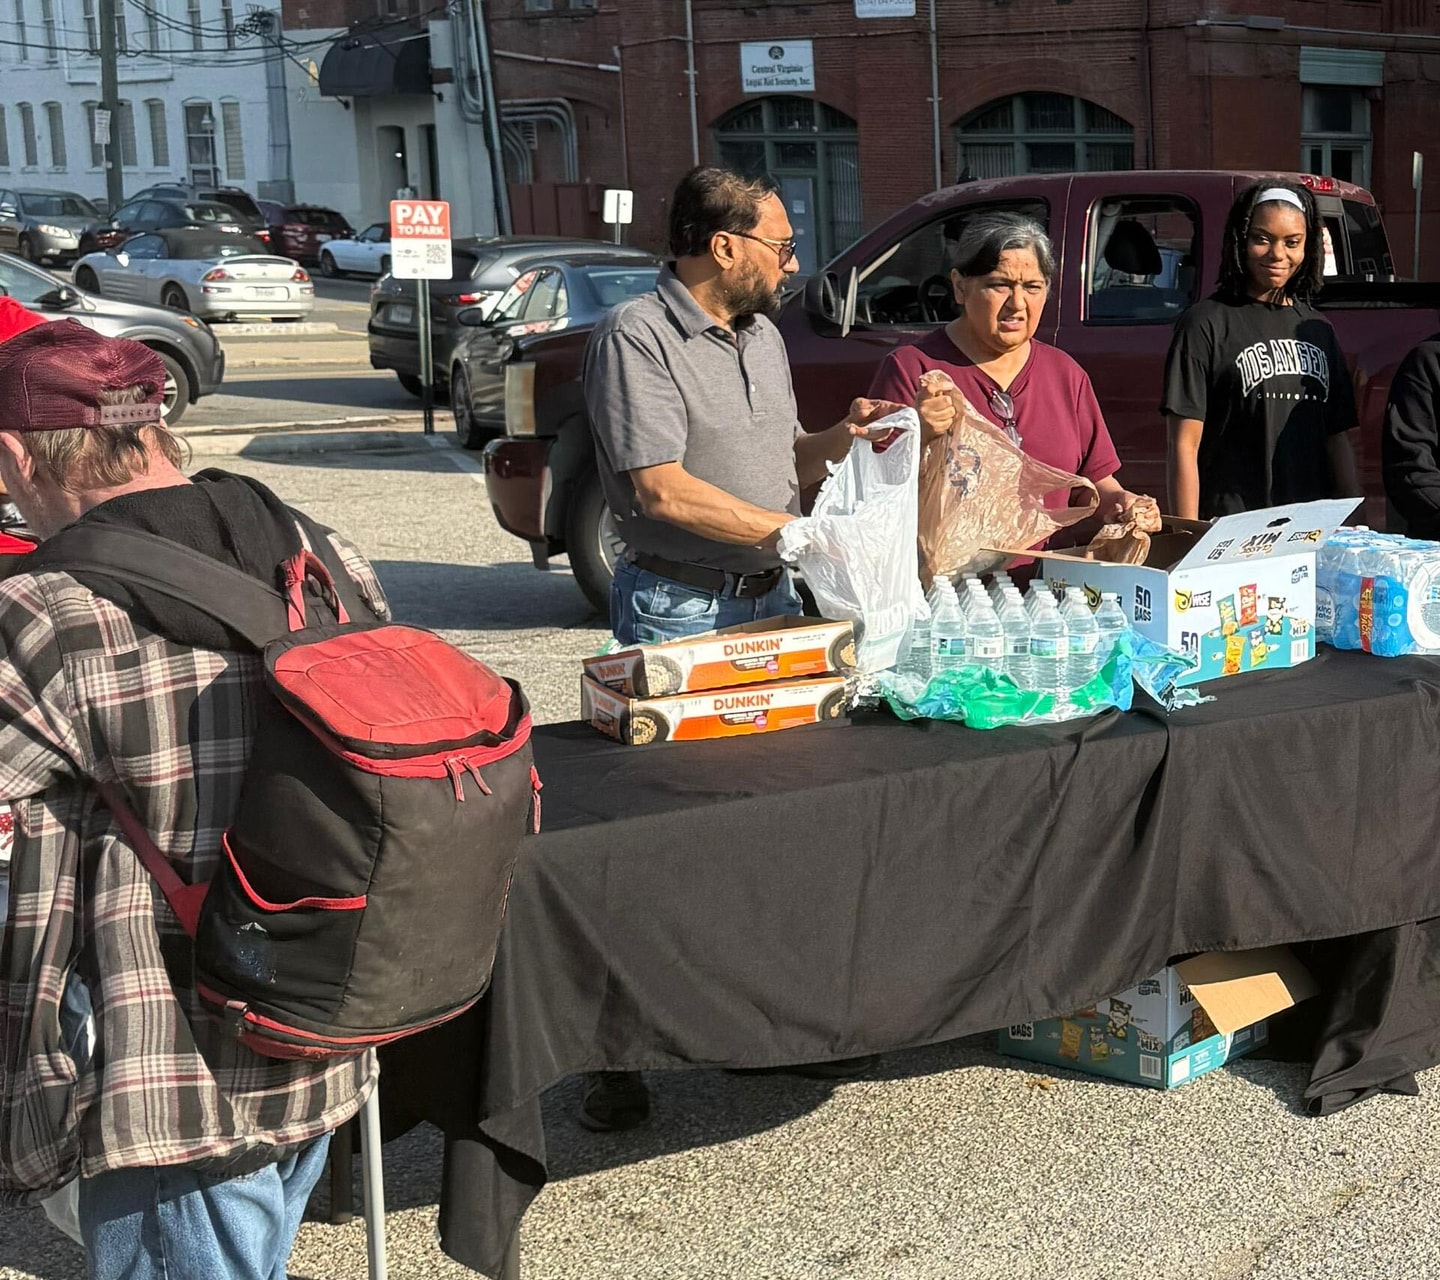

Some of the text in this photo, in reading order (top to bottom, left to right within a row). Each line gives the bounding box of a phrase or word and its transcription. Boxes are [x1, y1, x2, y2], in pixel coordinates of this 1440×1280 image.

[396, 204, 443, 225] PAY
[398, 225, 445, 236] TO PARK
[1235, 342, 1275, 398] LOS
[1135, 584, 1151, 610] 50
[723, 637, 783, 657] DUNKIN'
[713, 693, 774, 711] DUNKIN'
[1180, 989, 1194, 1006] MI
[1140, 1039, 1160, 1052] MIX
